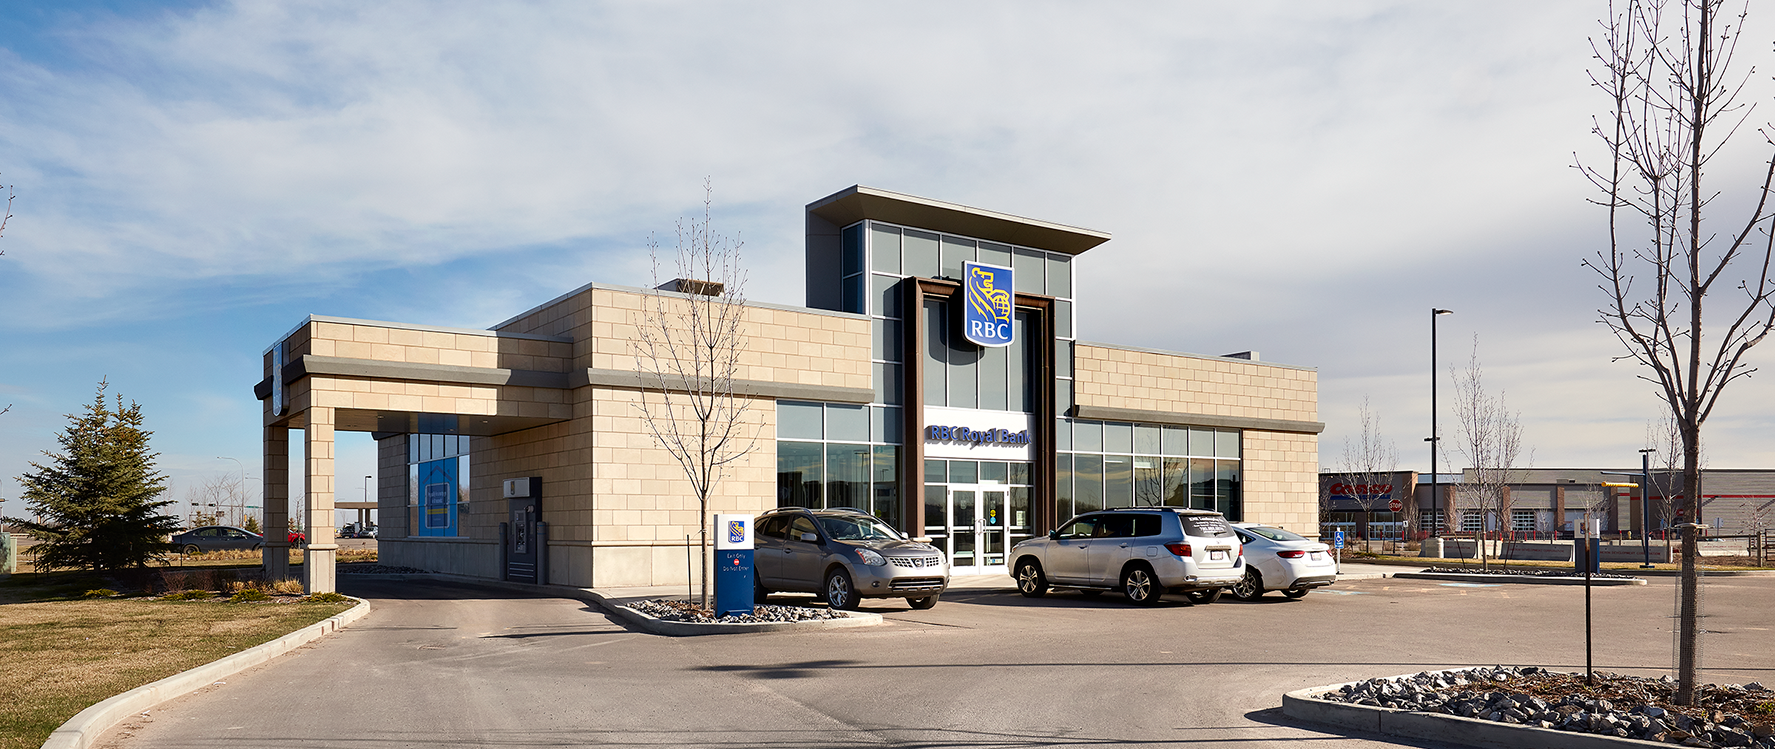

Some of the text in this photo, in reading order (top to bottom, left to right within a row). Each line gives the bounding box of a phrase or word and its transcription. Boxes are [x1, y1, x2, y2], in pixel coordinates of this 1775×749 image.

[971, 320, 1009, 340] RBC
[931, 425, 1032, 445] RBC Royal Bank
